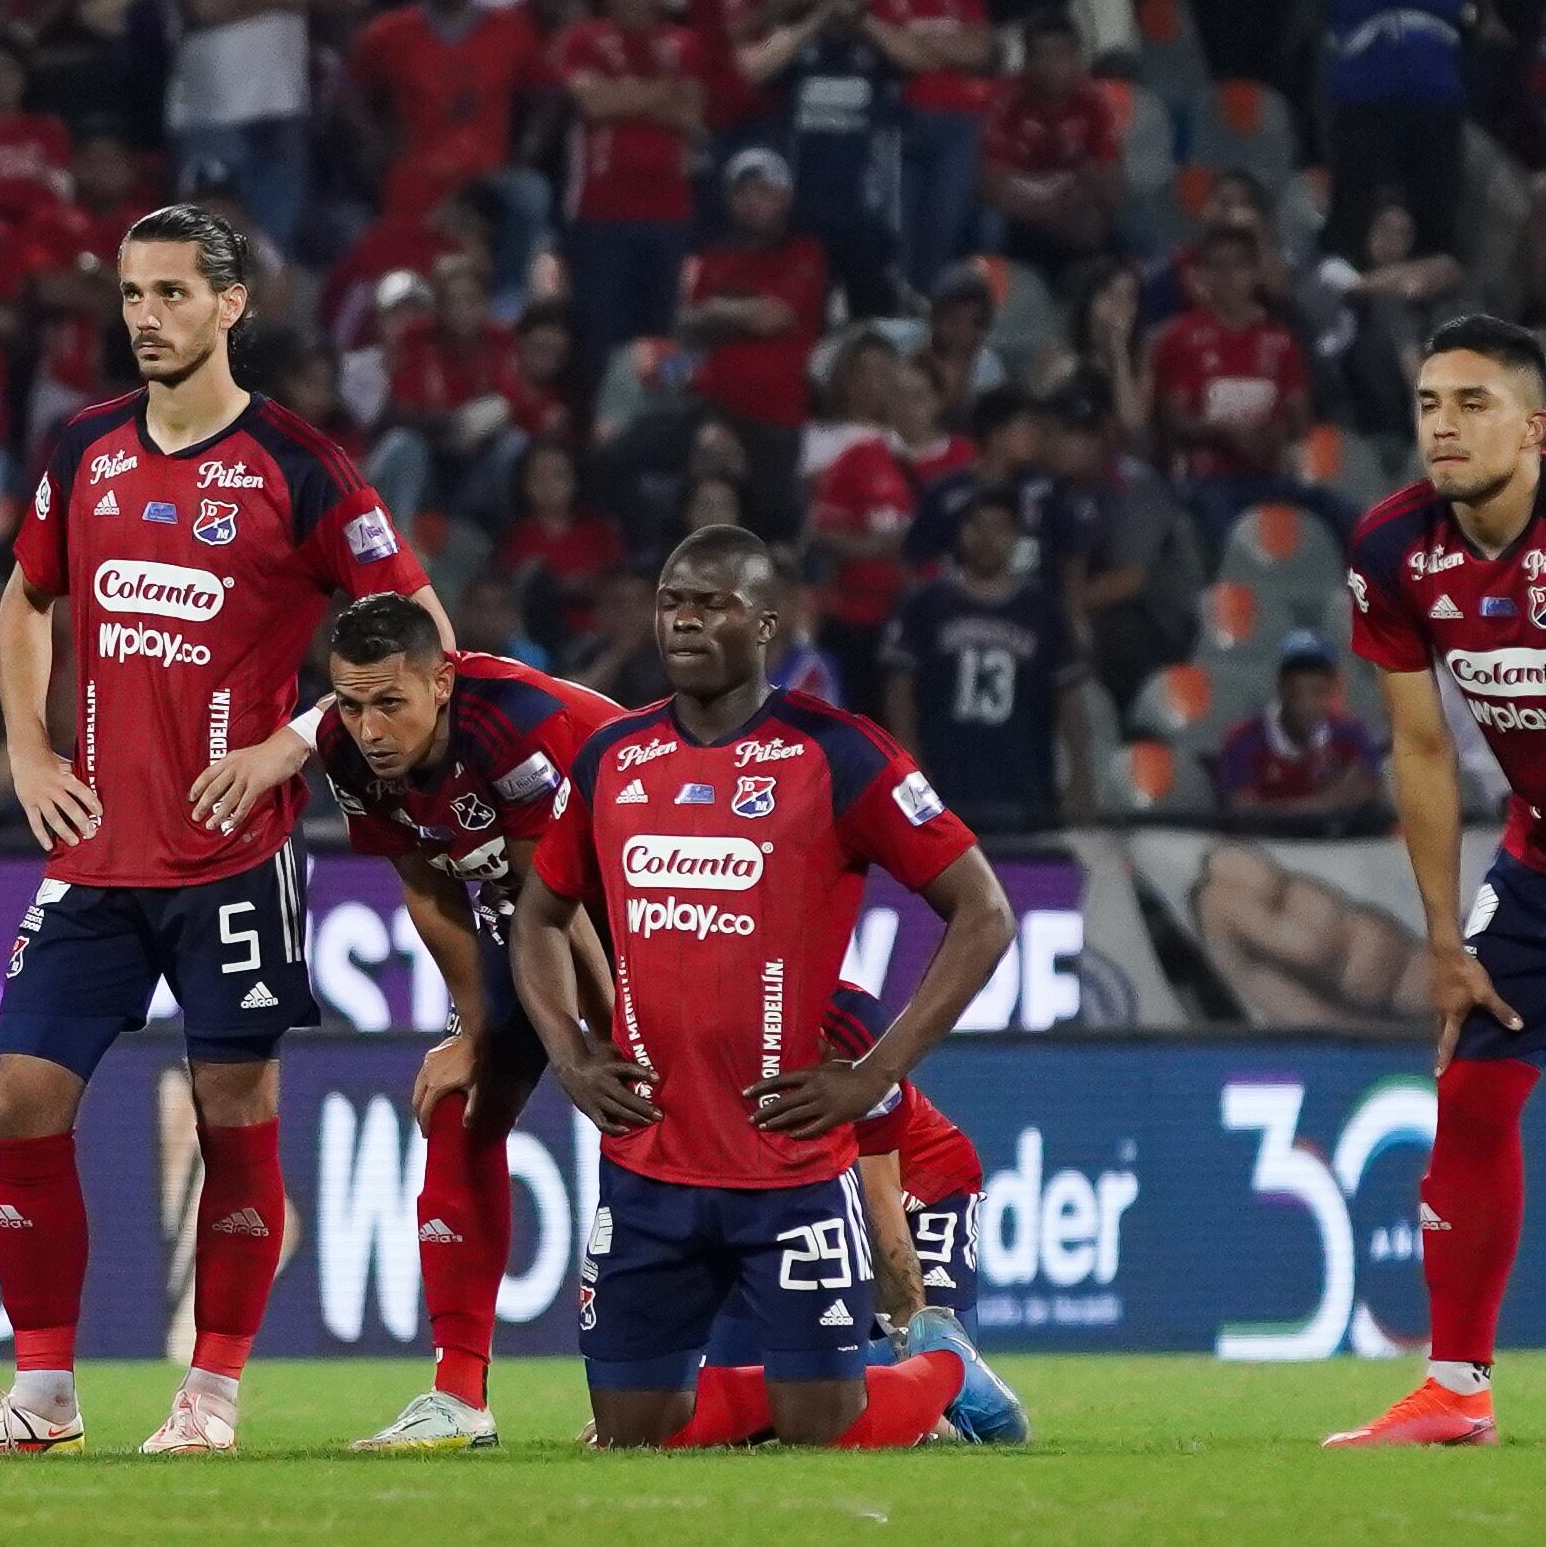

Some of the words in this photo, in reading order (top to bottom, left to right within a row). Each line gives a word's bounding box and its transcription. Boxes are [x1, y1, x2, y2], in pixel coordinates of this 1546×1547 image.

[90, 454, 138, 485] Pilsen
[197, 460, 264, 489] Pilsen
[99, 569, 220, 610] Colanta
[98, 621, 211, 667] Wplay.co
[210, 687, 231, 765] EDELLÍN.
[617, 740, 678, 772] Pilsen
[734, 739, 804, 768] Pilsen
[626, 845, 757, 879] Colanta
[218, 900, 262, 974] 5
[626, 895, 755, 940] Wplay.co
[240, 997, 279, 1009] adidas
[762, 958, 784, 1050] MEDELLÍN.
[978, 1126, 1140, 1288] der
[776, 1217, 853, 1291] 29
